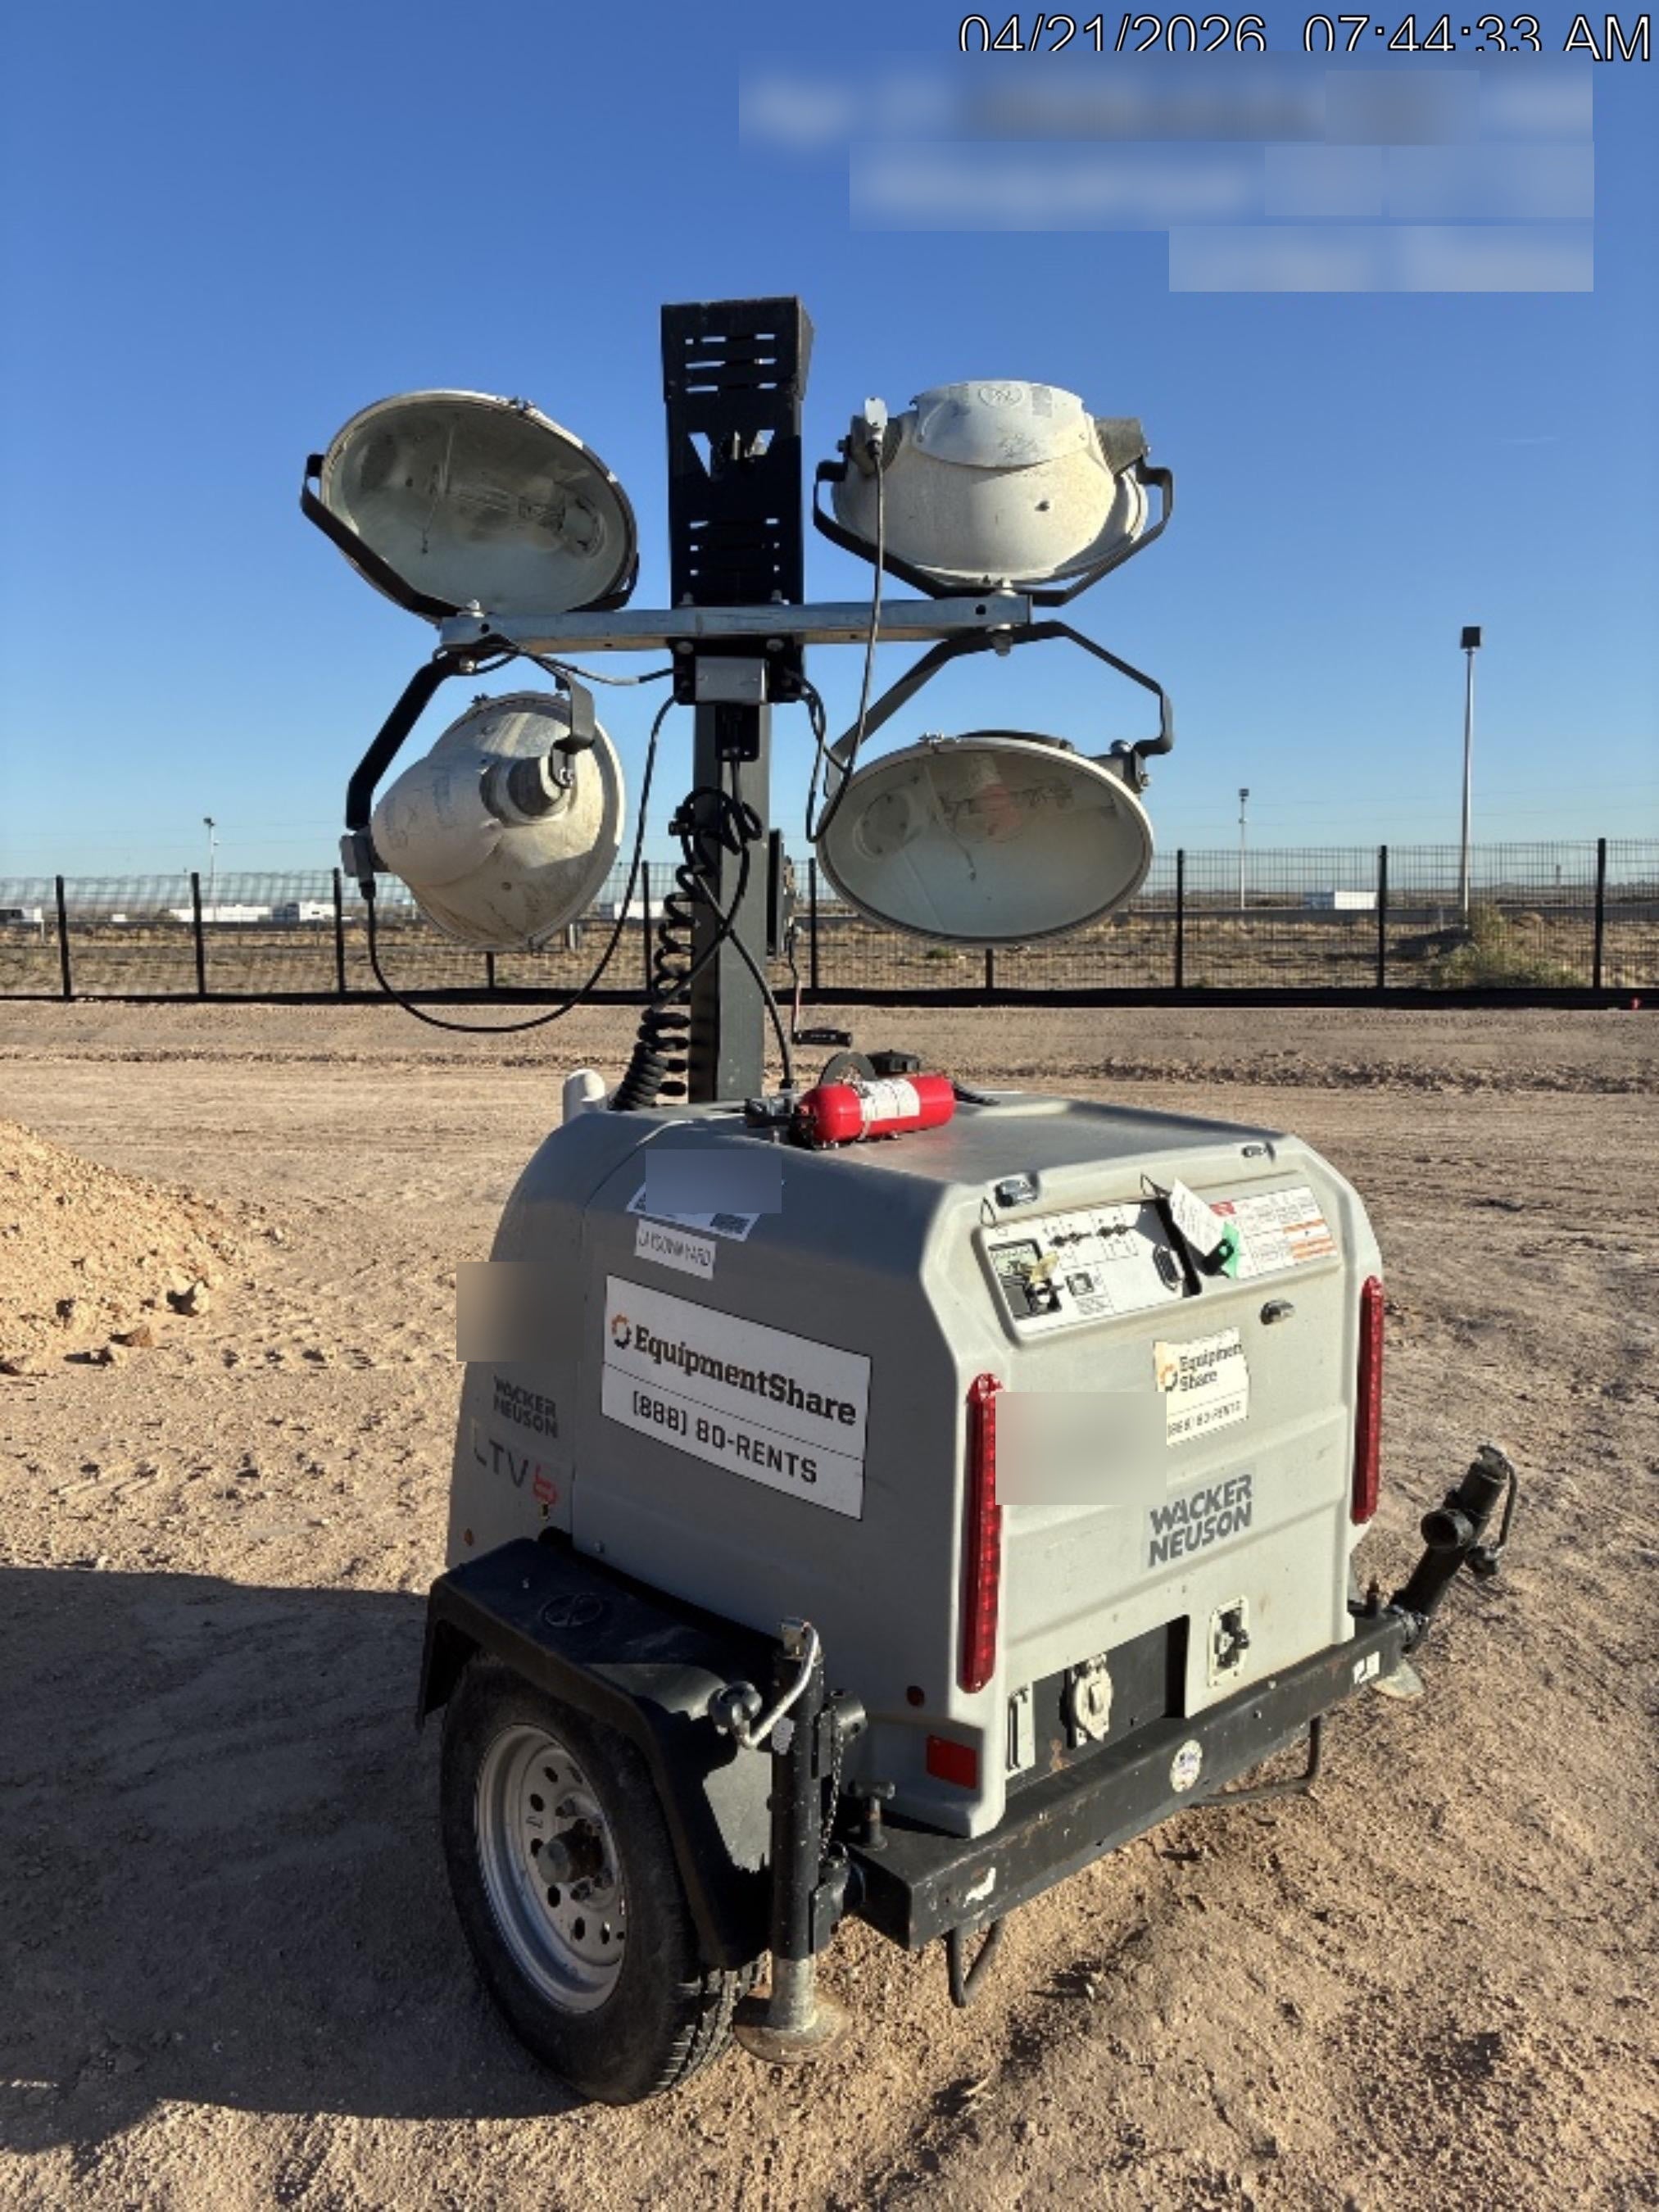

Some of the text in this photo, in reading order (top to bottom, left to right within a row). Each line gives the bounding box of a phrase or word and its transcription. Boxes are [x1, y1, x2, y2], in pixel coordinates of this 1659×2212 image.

[493, 1376, 557, 1419] WACKER
[634, 1324, 858, 1426] EquipmentShare
[493, 1394, 559, 1439] NEUSON
[696, 1417, 818, 1484] 80-RENTS
[1148, 1501, 1253, 1569] NEUSON
[1149, 1474, 1253, 1536] WACKER
